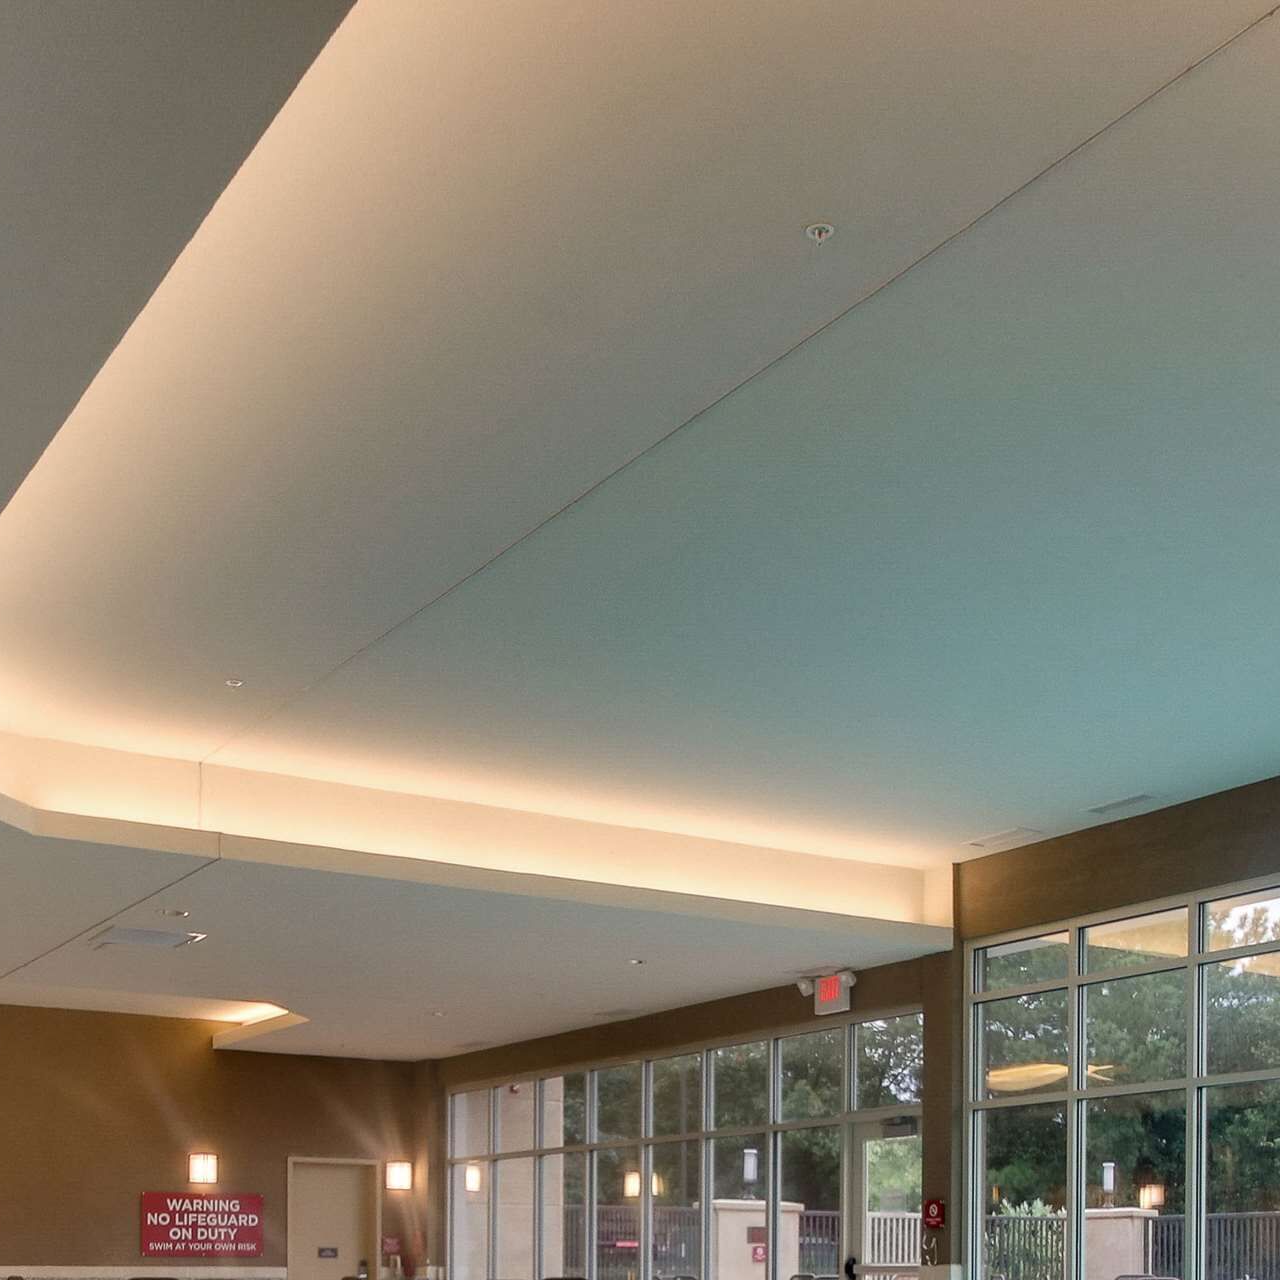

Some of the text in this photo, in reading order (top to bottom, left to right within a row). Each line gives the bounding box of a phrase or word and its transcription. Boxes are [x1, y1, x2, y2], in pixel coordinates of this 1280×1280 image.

[166, 1199, 240, 1212] WARNING
[147, 1213, 259, 1227] NO LIFEGUARD
[169, 1227, 238, 1241] ON DUTY
[149, 1242, 257, 1251] SWIM AT YOUR OWN RISK
